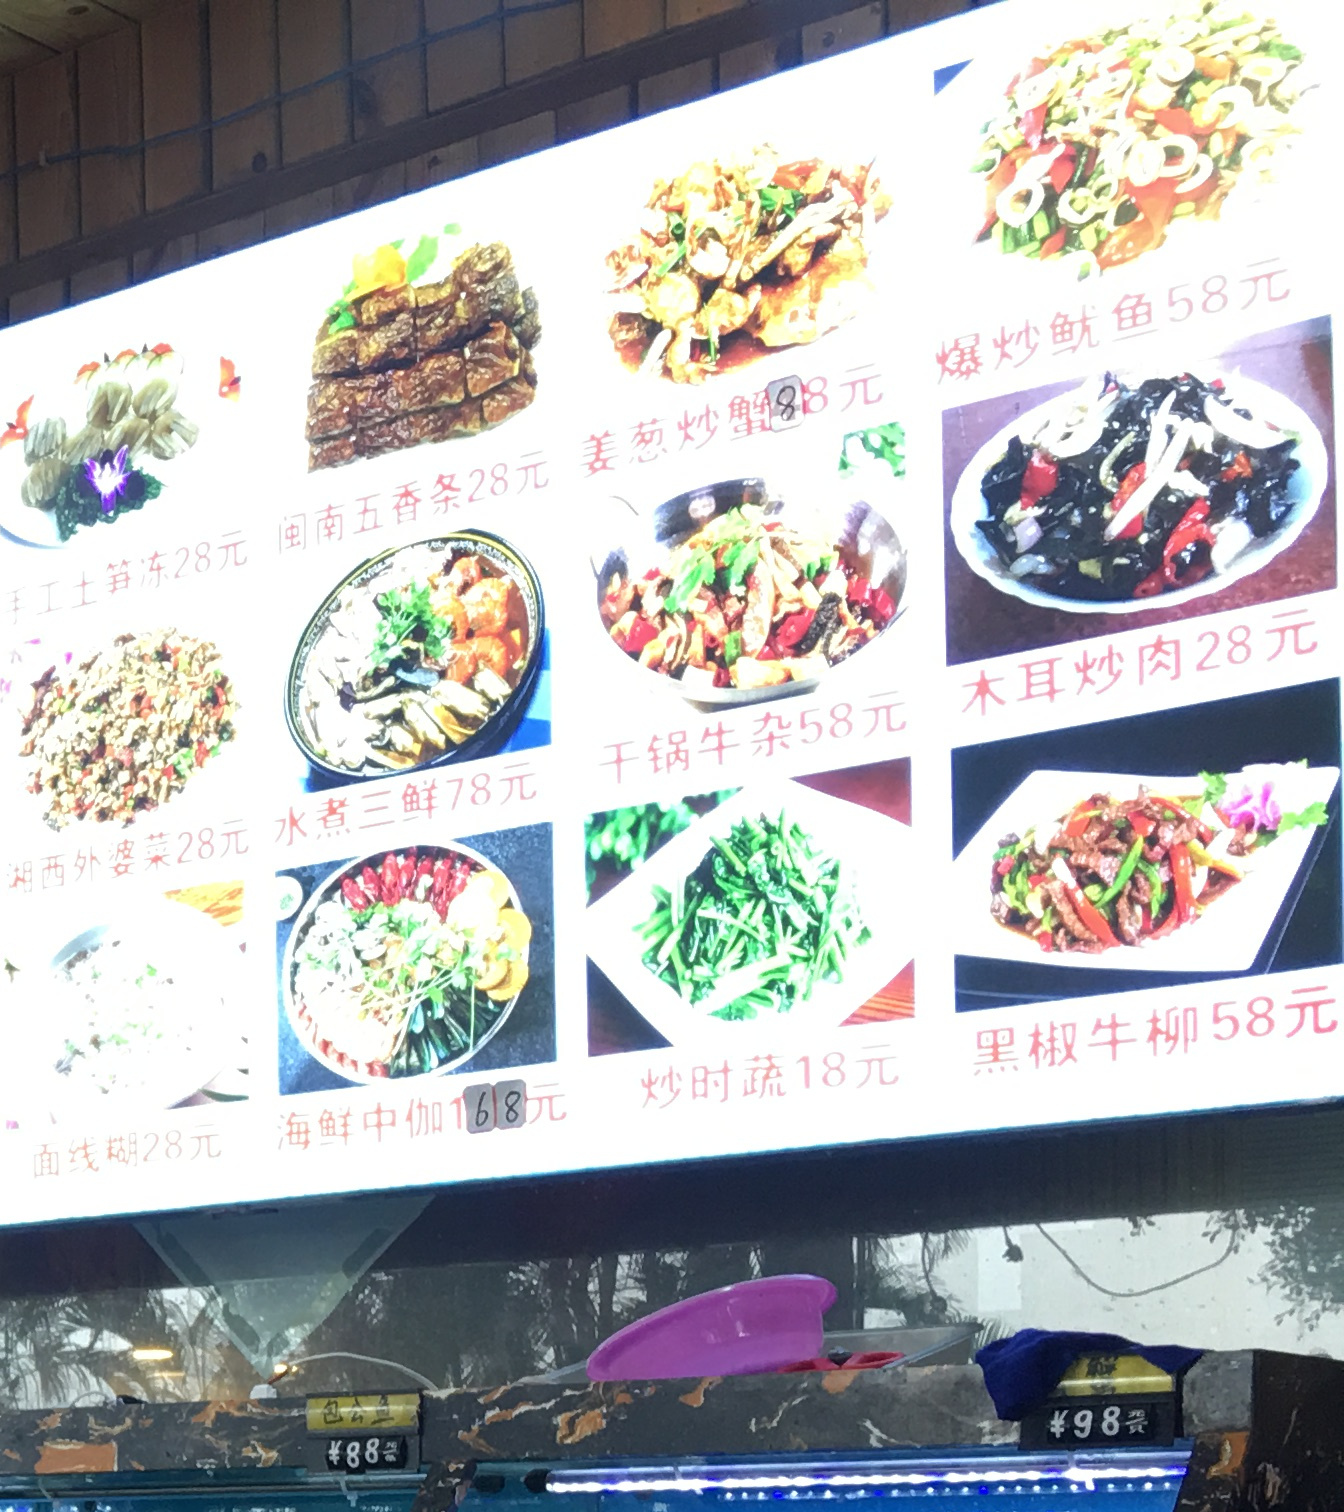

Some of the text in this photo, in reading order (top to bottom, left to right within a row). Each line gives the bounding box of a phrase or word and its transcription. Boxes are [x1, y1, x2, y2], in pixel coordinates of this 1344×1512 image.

[935, 258, 1291, 384] 爆炒鱿鱼58元
[278, 451, 550, 557] 闽南五香条28元
[961, 609, 1319, 716] 木耳炒肉28元
[598, 691, 908, 784] 干锅牛杂58元
[274, 769, 538, 847] 水煮三鲜78元
[973, 985, 1340, 1076] 黑椒牛柳58元
[640, 1045, 900, 1109] 炒时蔬18元
[33, 1124, 222, 1179] 面线糊28元
